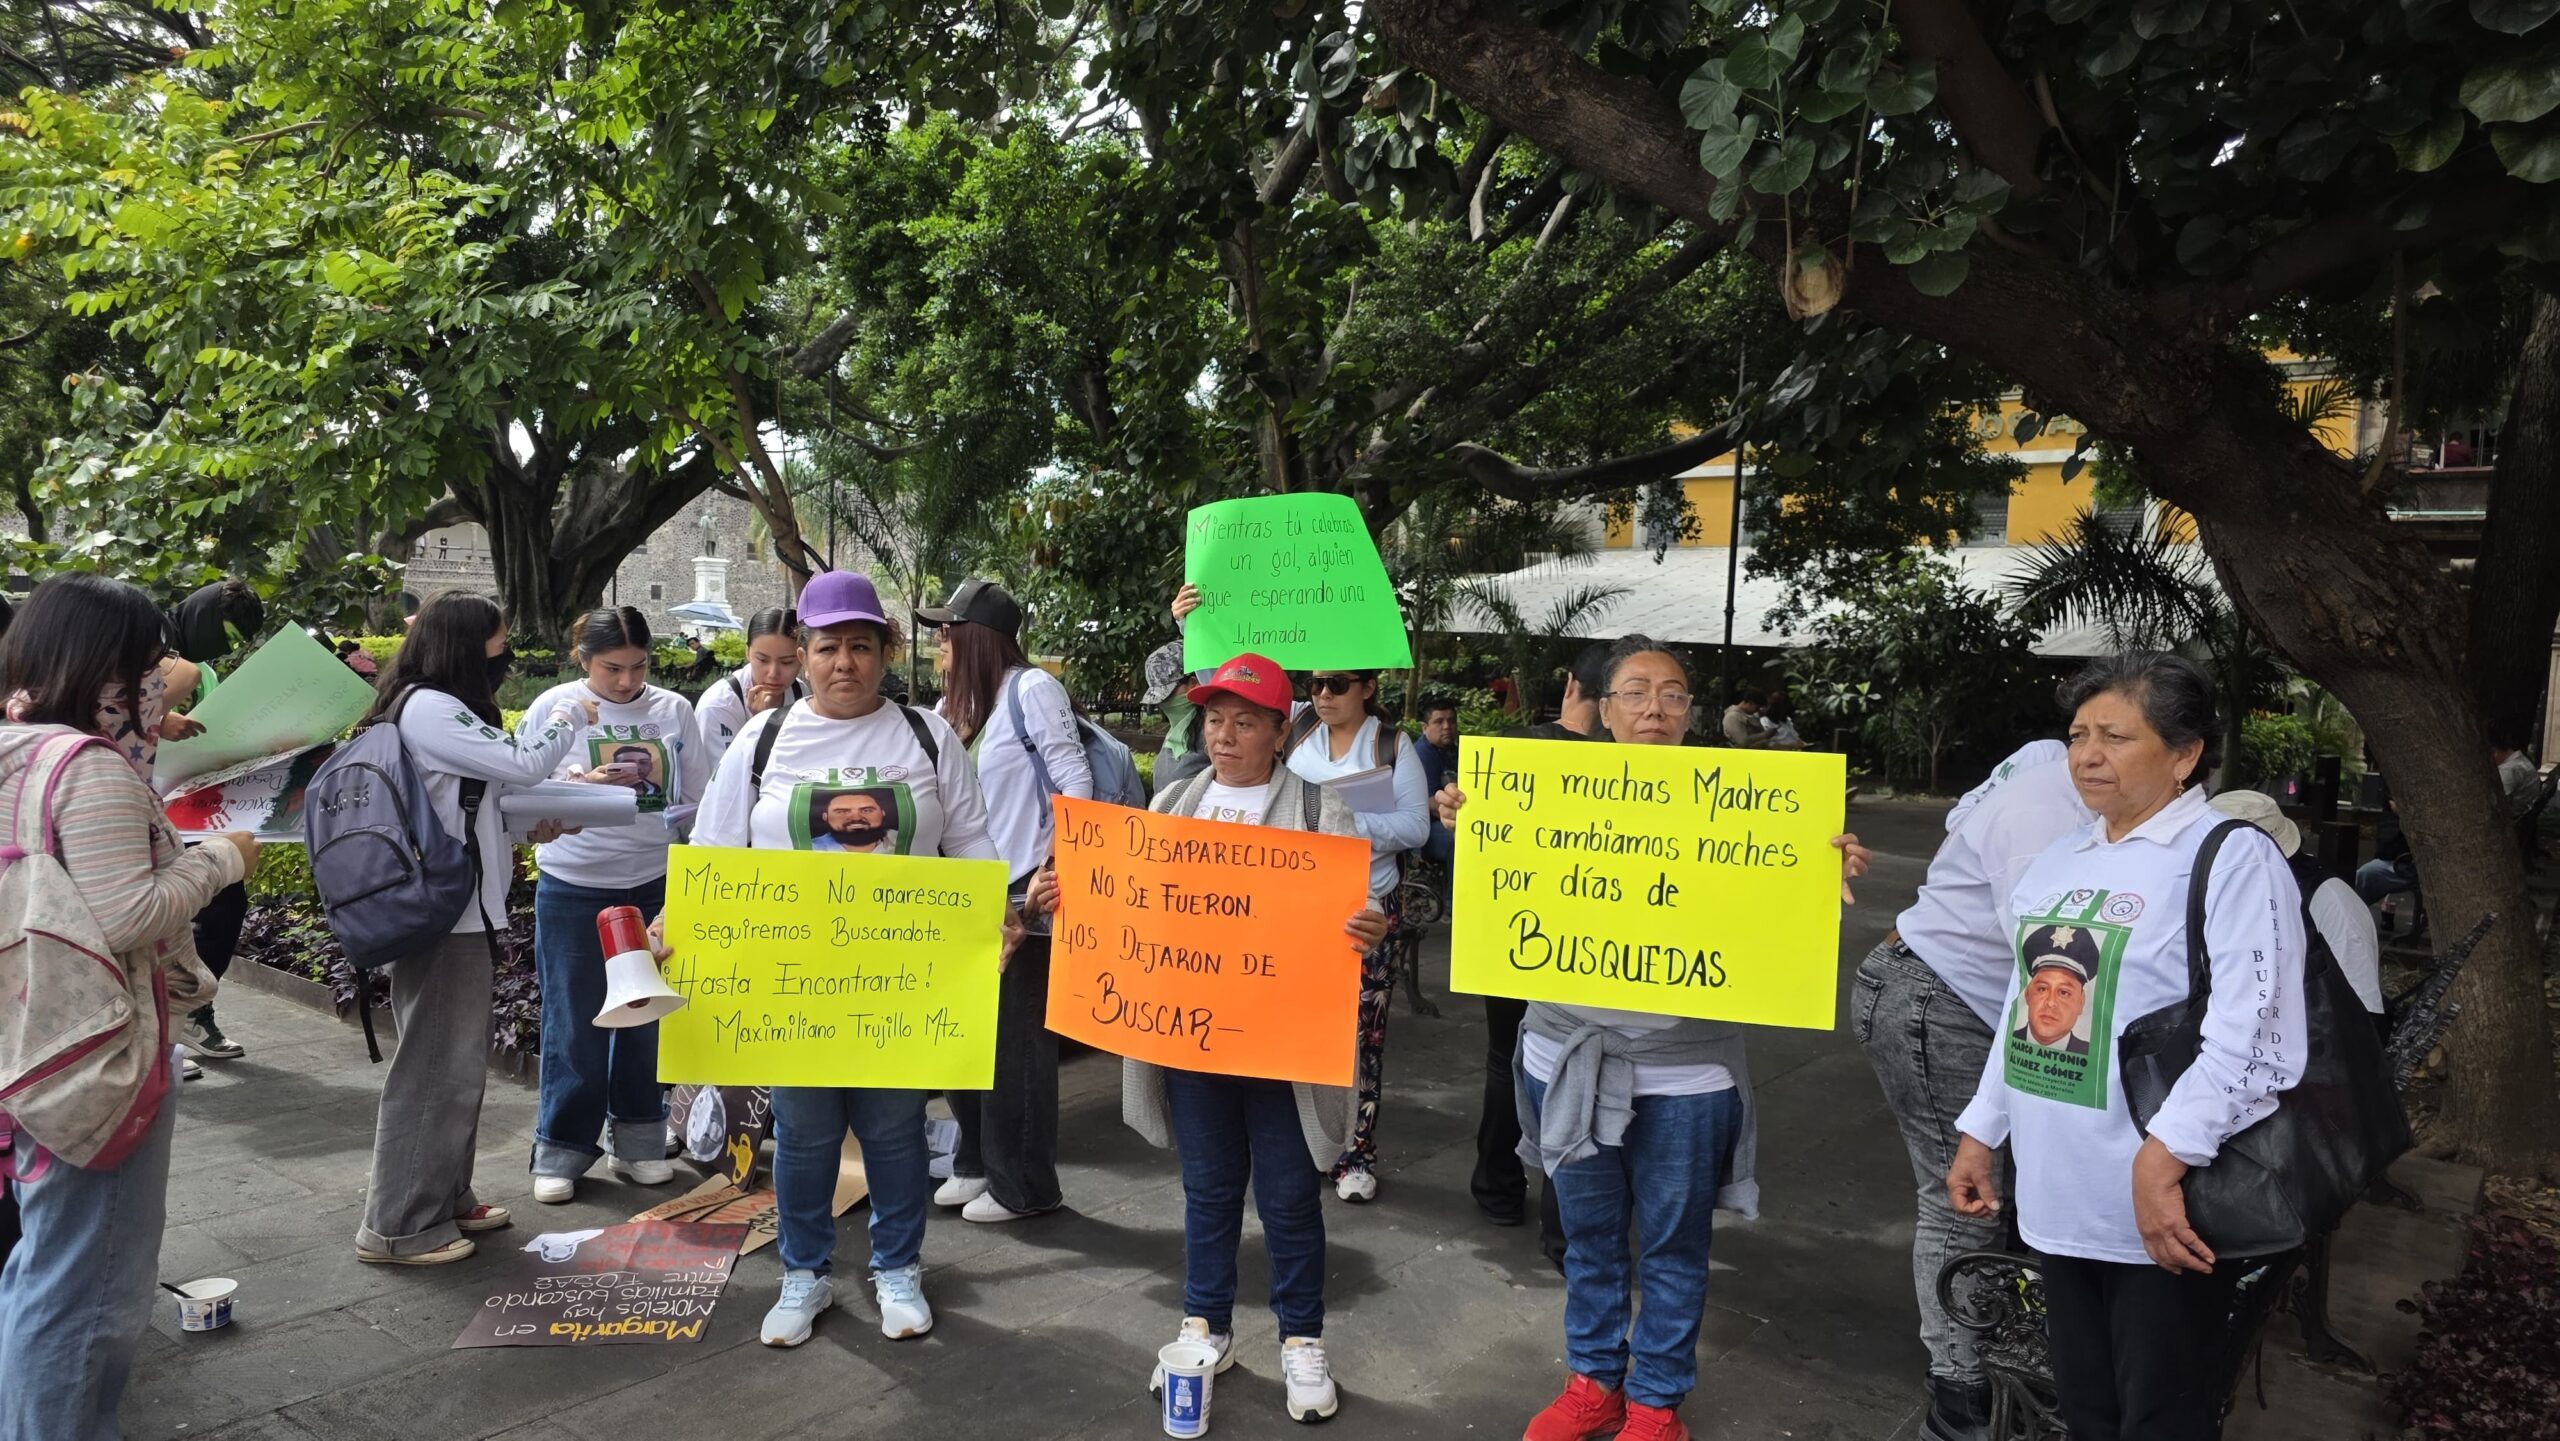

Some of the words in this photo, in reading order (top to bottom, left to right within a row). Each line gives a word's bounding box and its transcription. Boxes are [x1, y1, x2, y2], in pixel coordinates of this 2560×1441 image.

[1191, 512, 1272, 544] Mientras
[1284, 510, 1302, 536] tú
[1231, 554, 1251, 570] un
[1271, 544, 1300, 577] gol,
[1309, 542, 1353, 572] alguien
[1251, 580, 1333, 611] esperando
[1340, 586, 1365, 603] una
[1466, 747, 1535, 811] Hay
[1561, 760, 1670, 804] muchas
[1694, 766, 1800, 823] Madres
[1062, 808, 1104, 852] LOS
[1125, 815, 1317, 872] DESAPARECIDOS
[1471, 820, 1513, 853] que
[1535, 819, 1680, 860] cambiamos
[1697, 830, 1798, 867] noches
[685, 862, 799, 905] Mientras
[828, 867, 855, 904] No
[873, 888, 971, 912] aparescas
[1090, 865, 1114, 898] NO
[1126, 875, 1149, 909] SE
[1160, 883, 1257, 918] FUERON.
[1492, 868, 1538, 901] por
[1560, 863, 1622, 902] días
[1647, 872, 1679, 908] de
[693, 918, 811, 949] seguiremos
[831, 917, 946, 947] Buscandote.
[1059, 906, 1097, 954] LOS
[1119, 925, 1221, 976] DEJARON
[1240, 953, 1276, 977] DE
[1508, 909, 1732, 988] BUSQUEDAS.
[713, 1010, 836, 1054] Maximiliano
[847, 1012, 911, 1049] Trujillo
[925, 1007, 964, 1046] Mtz.
[2223, 950, 2268, 1095] BUSCADRAS
[2010, 1040, 2034, 1055] MARCO
[2036, 1048, 2088, 1067] ANTONIO
[621, 1285, 720, 1300] Familias
[662, 1272, 728, 1284] entre
[485, 1288, 608, 1314] buscando
[563, 1304, 606, 1320] hay
[616, 1299, 716, 1317] Morelos
[494, 1324, 536, 1337] en
[550, 1316, 703, 1342] Margarita
